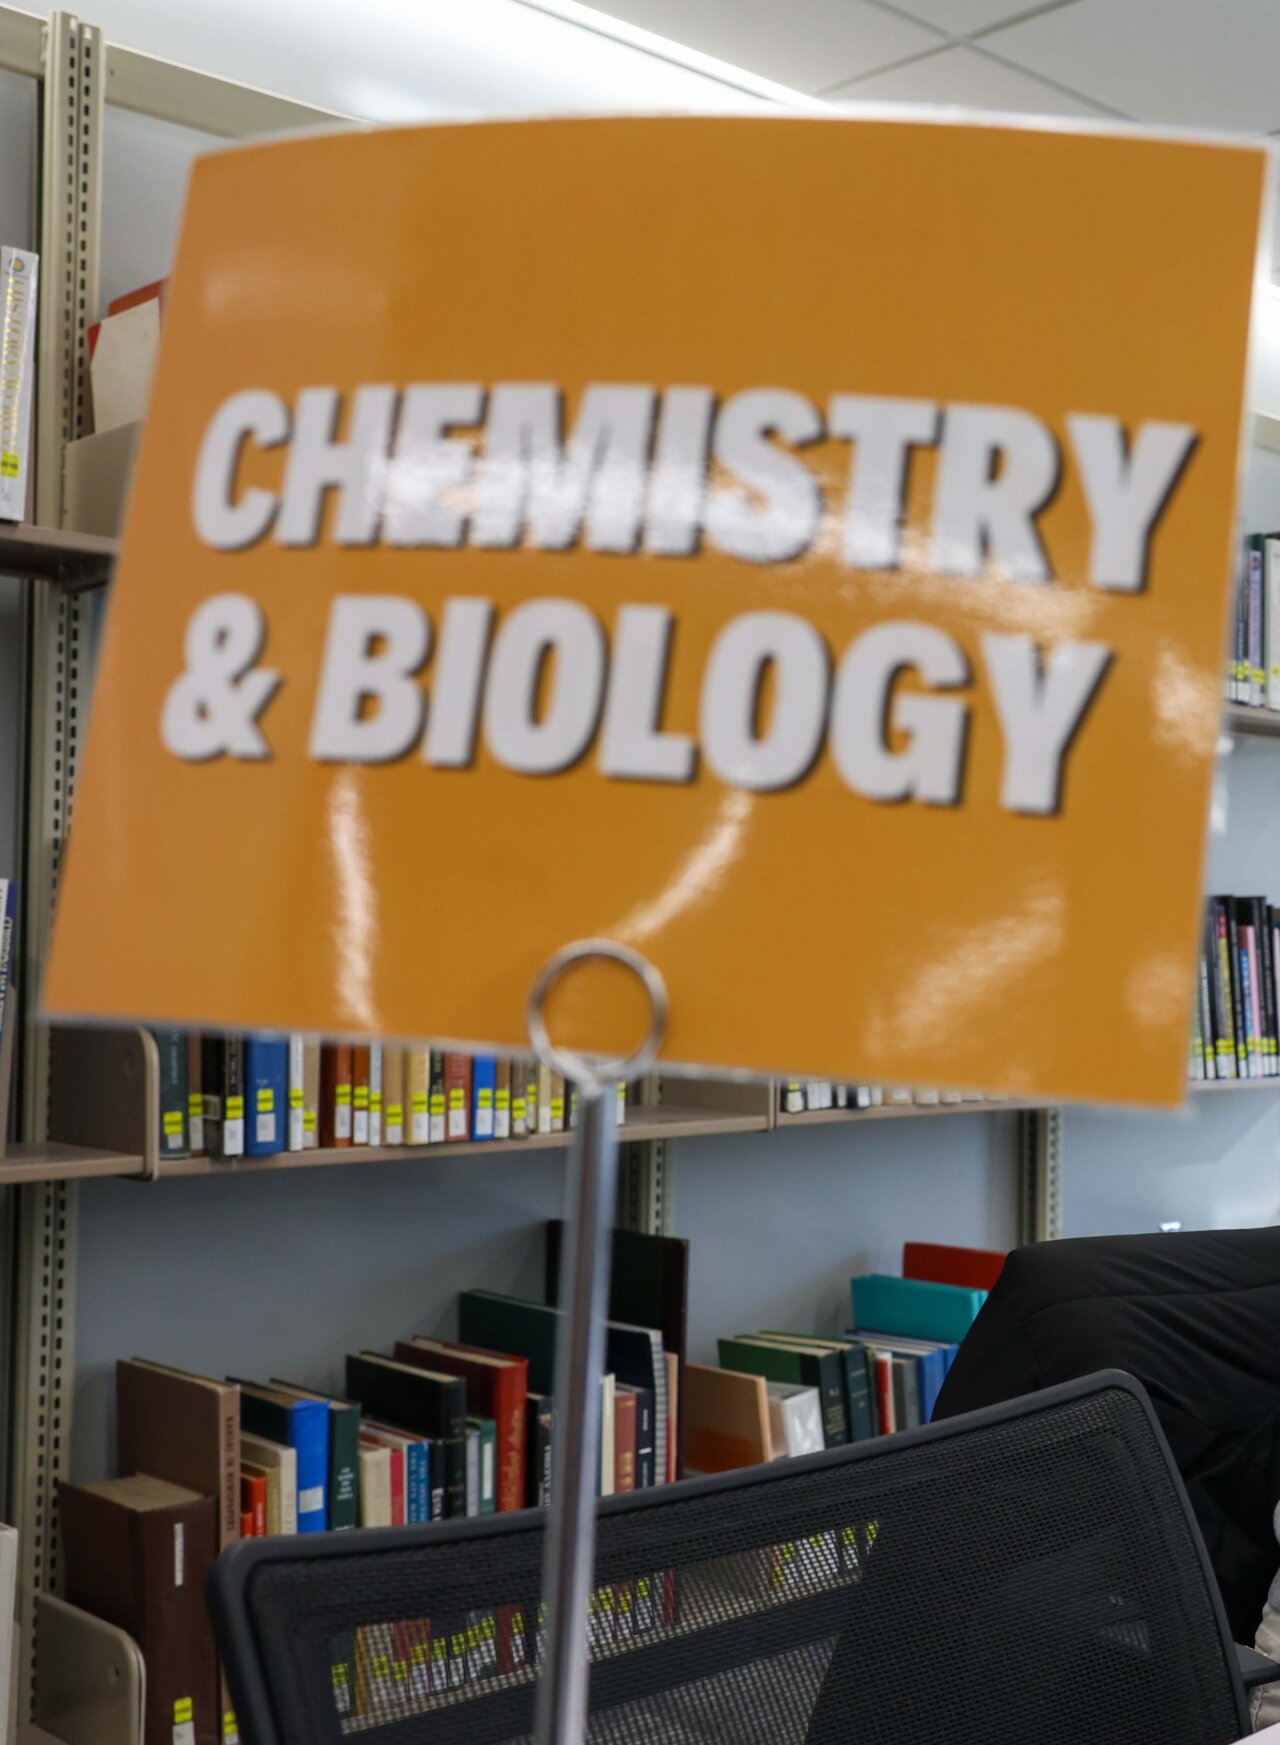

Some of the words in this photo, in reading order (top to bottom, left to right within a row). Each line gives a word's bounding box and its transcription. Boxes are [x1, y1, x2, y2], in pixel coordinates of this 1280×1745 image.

[191, 381, 1200, 592] CHEMISTRY
[161, 593, 285, 762] &
[309, 593, 1116, 816] BIOLOGY
